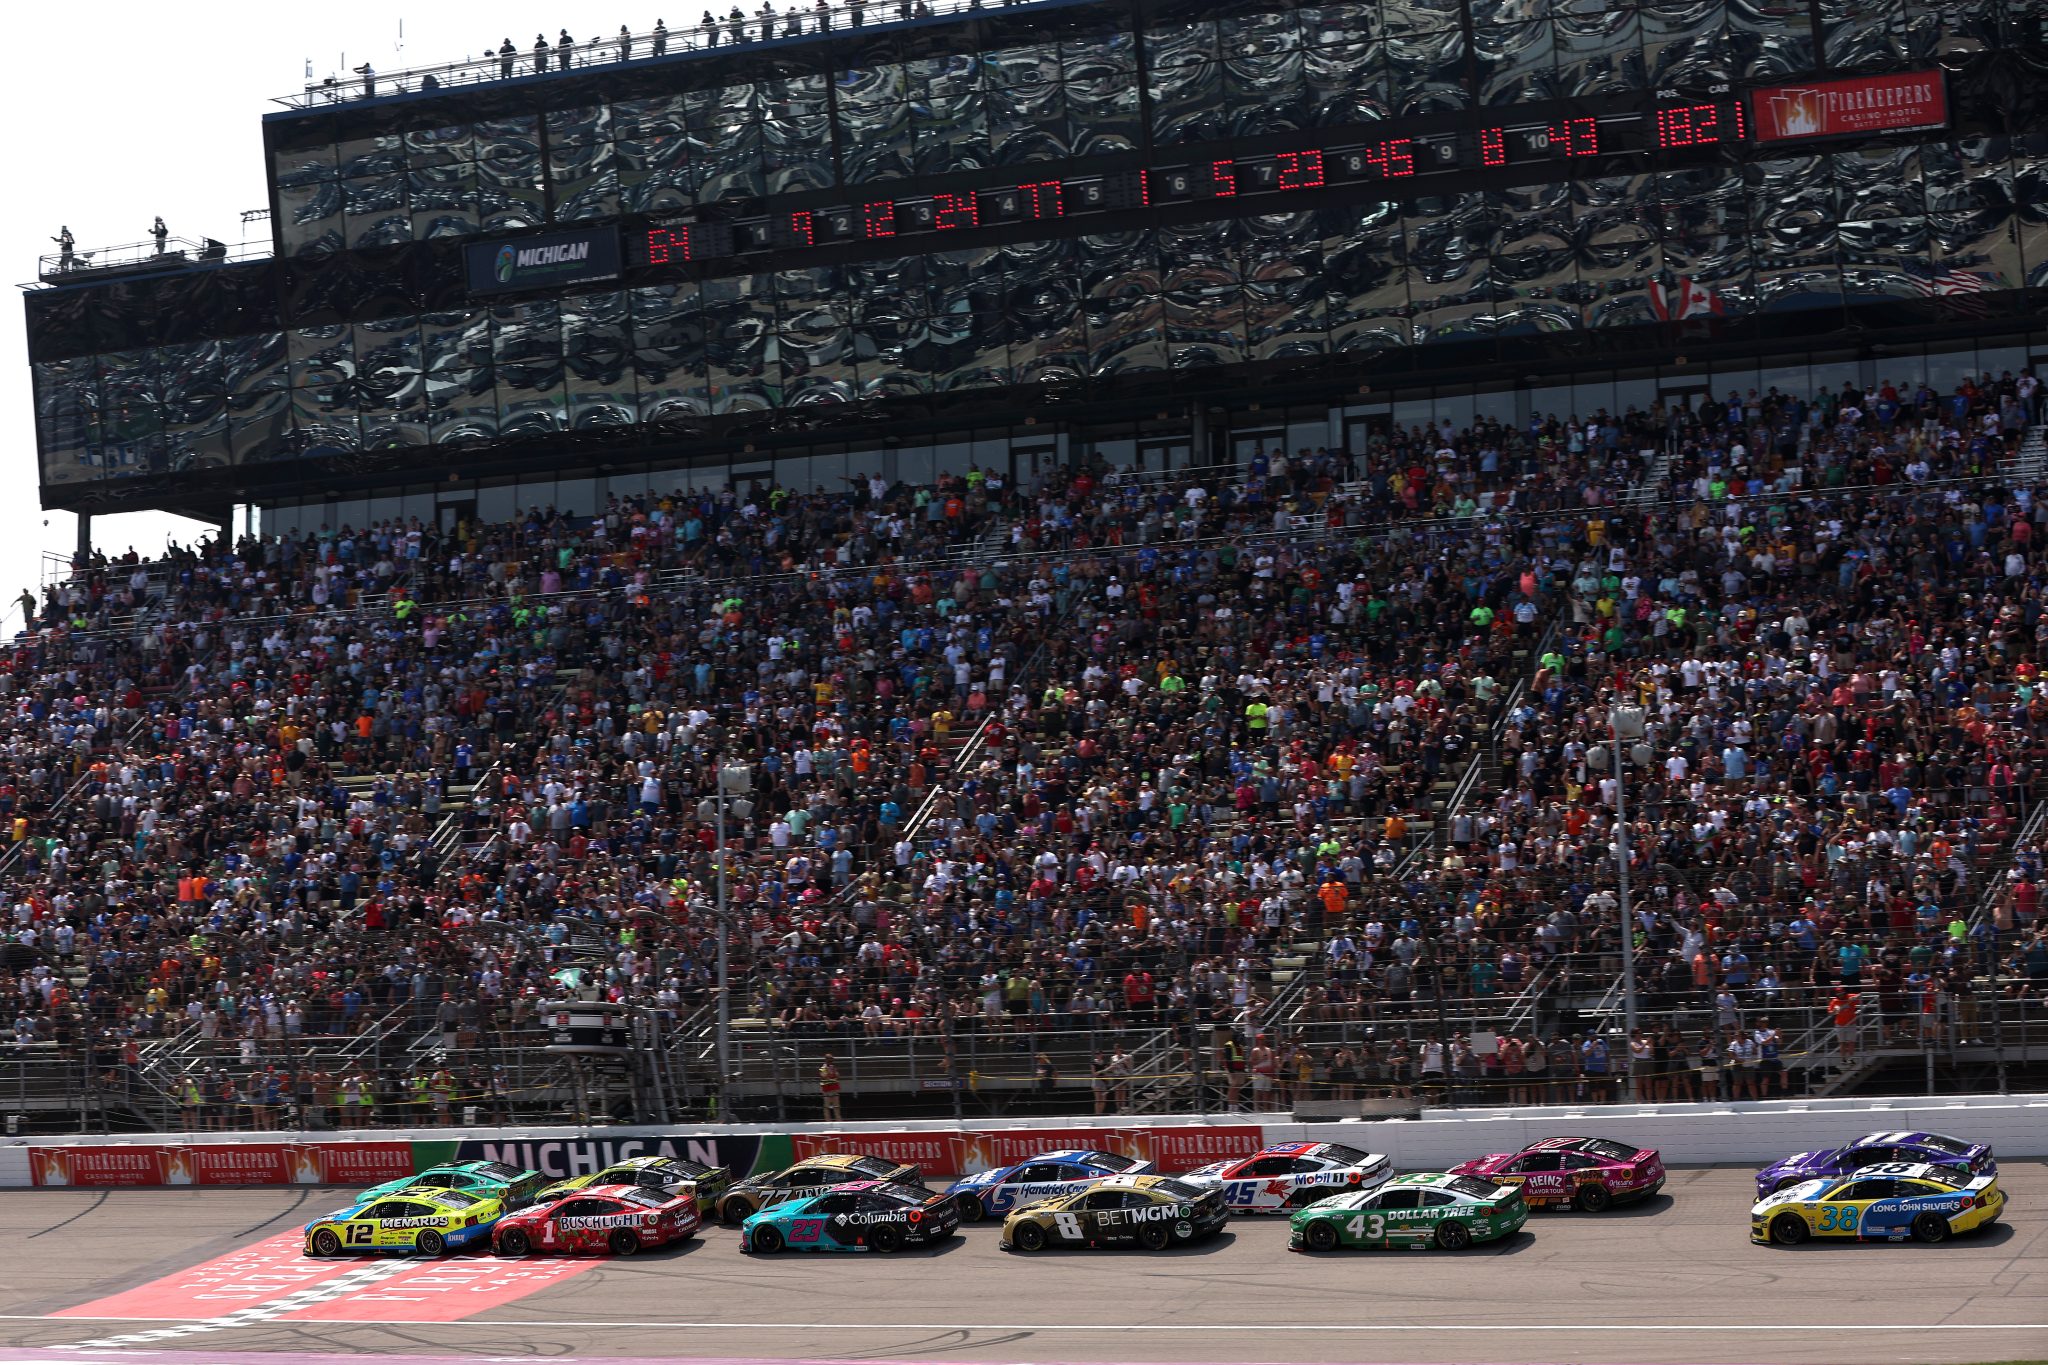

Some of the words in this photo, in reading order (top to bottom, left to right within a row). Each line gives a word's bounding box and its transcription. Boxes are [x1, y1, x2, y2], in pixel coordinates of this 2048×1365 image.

[1708, 84, 1729, 93] CAR
[1829, 84, 1932, 112] FIREKEEPERS
[1841, 111, 1881, 122] CASINO
[1889, 106, 1922, 116] HOTEL
[1481, 127, 1505, 166] 8
[1527, 133, 1549, 149] 10
[1549, 117, 1599, 157] 43
[1366, 139, 1415, 178] 45
[1441, 145, 1453, 160] 9
[1262, 165, 1273, 181] 7
[1276, 150, 1325, 190] 23
[1350, 156, 1361, 171] 8
[1140, 169, 1150, 205] 1
[1174, 176, 1186, 191] 6
[1213, 159, 1236, 197] 5
[1017, 180, 1064, 218] 77
[1088, 186, 1099, 201] 5
[919, 207, 930, 221] 3
[934, 191, 978, 229] 24
[1003, 197, 1015, 212] 4
[792, 211, 813, 245] 9
[837, 216, 848, 232] 2
[864, 201, 896, 238] 12
[757, 227, 766, 240] 1
[648, 225, 691, 264] 64
[516, 242, 590, 268] MICHIGAN
[849, 1140, 942, 1160] FIREKEEPERS
[1161, 1134, 1259, 1155] FIREKEEPERS
[75, 1153, 151, 1171] FIREKEEPERS
[199, 1151, 279, 1169] FIREKEEPERS
[328, 1149, 410, 1168] FIREKEEPERS
[209, 1171, 241, 1179] CASINO
[1295, 1173, 1331, 1185] Mobil
[1529, 1175, 1563, 1188] HEINZ
[759, 1189, 792, 1211] 77
[992, 1188, 1019, 1211] 5
[1224, 1182, 1258, 1205] 45
[1097, 1205, 1180, 1226] BETMGM
[1388, 1209, 1440, 1221] DOLLAR
[1443, 1206, 1476, 1218] TREE
[1873, 1205, 1897, 1213] LONG
[1899, 1203, 1920, 1212] JOHN
[1922, 1200, 1961, 1211] SILVER'S
[380, 1217, 448, 1230] MENARDS
[562, 1216, 601, 1230] BUSCH
[603, 1213, 642, 1227] LIGHT
[849, 1210, 906, 1225] Columbia
[1054, 1212, 1084, 1239] 8
[1346, 1214, 1386, 1239] 43
[1818, 1206, 1859, 1231] 38
[345, 1224, 374, 1244] 12
[543, 1220, 555, 1243] 1
[788, 1219, 822, 1242] 23
[346, 1254, 530, 1301] FIREK
